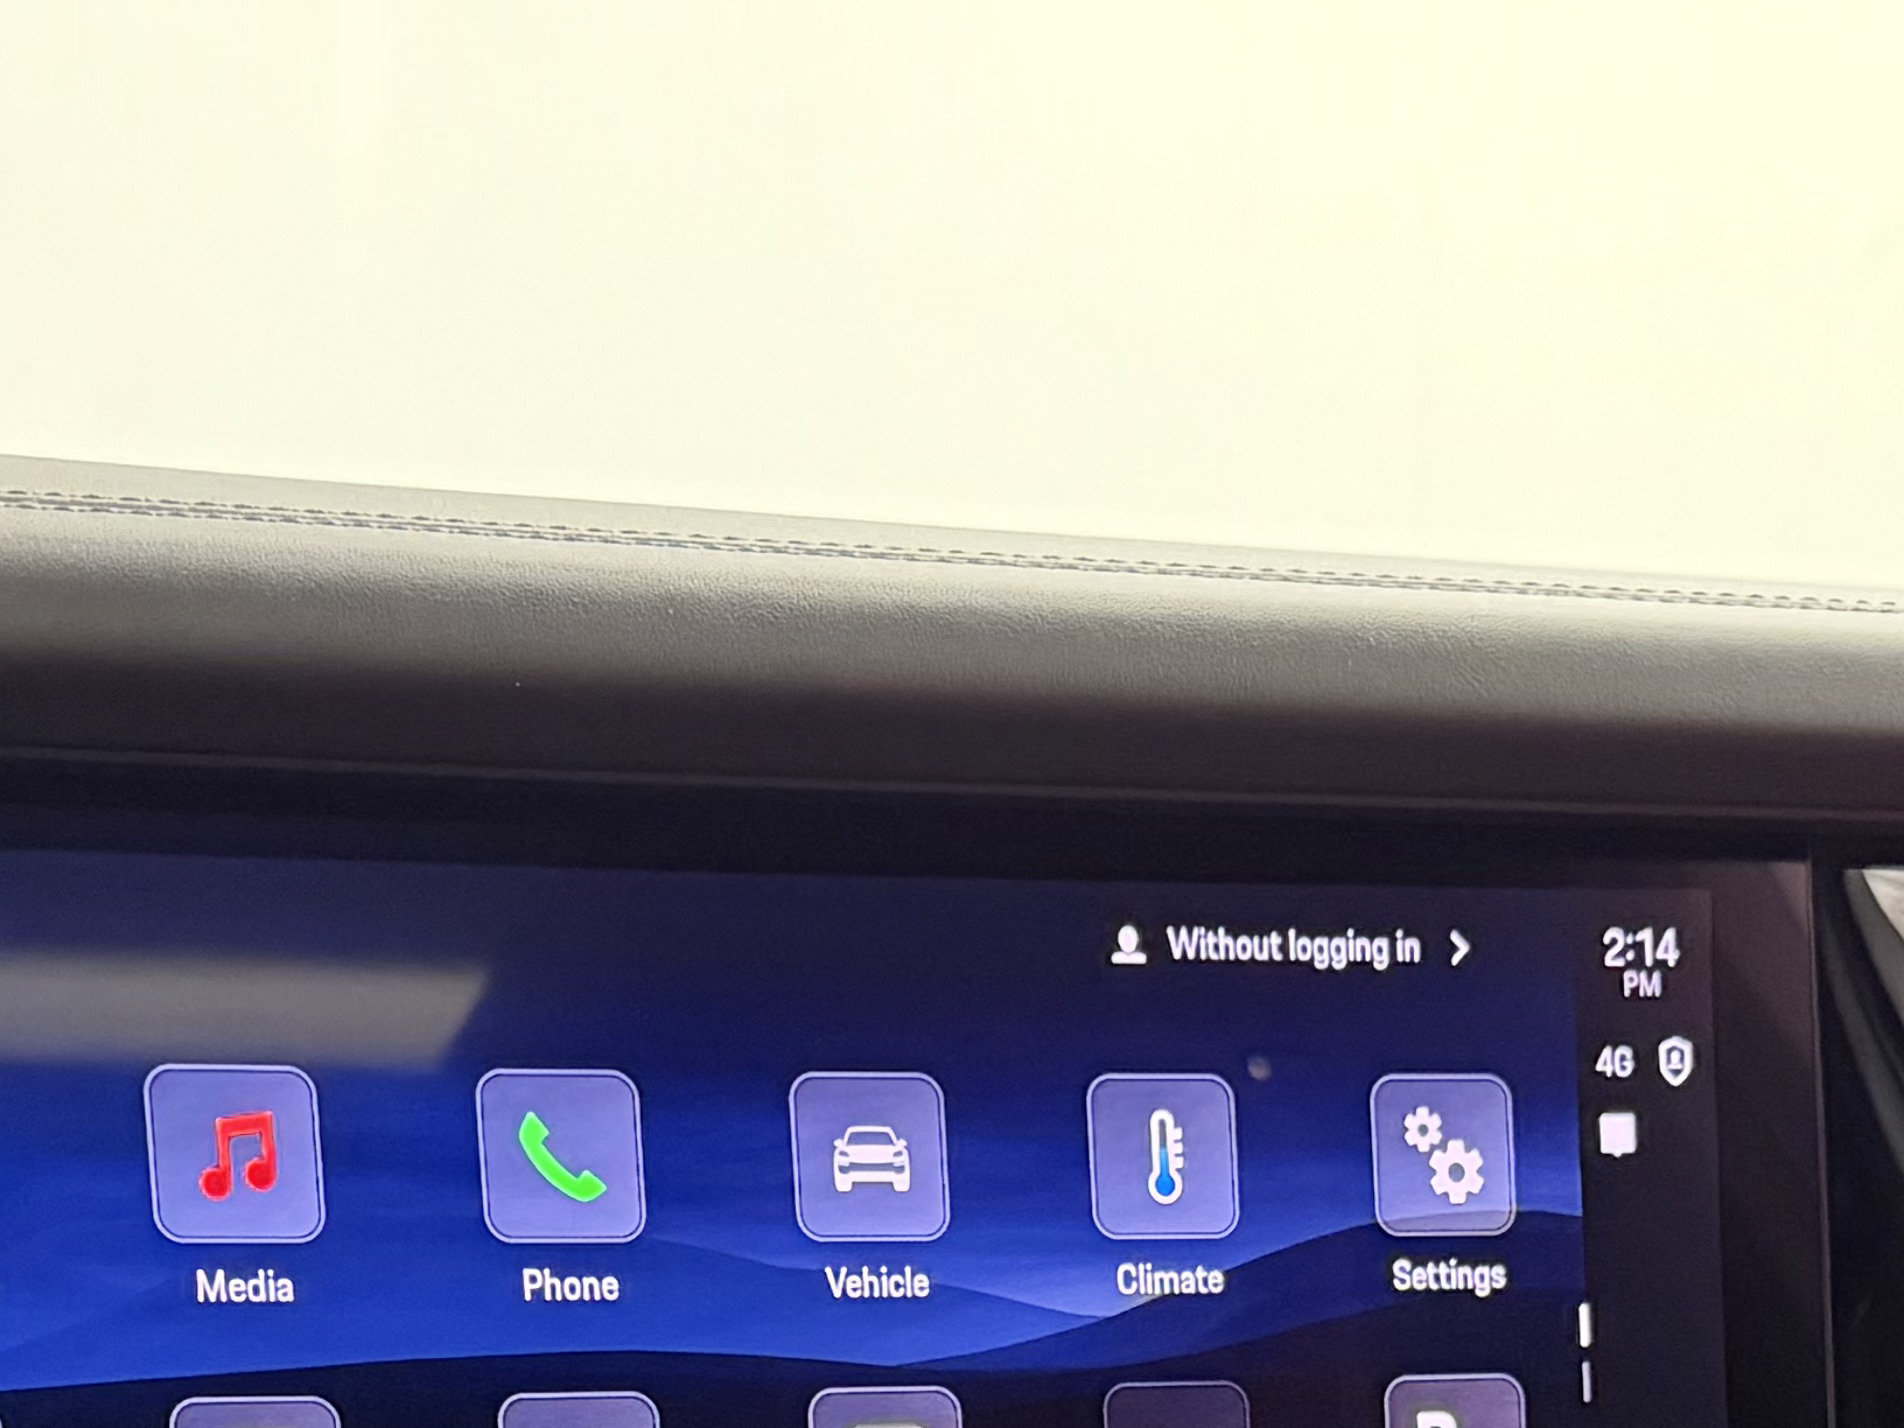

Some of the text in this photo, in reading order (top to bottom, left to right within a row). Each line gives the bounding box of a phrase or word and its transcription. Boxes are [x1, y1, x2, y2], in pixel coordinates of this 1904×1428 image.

[1166, 925, 1422, 971] Without logging in
[1602, 926, 1681, 968] 2:14
[1622, 970, 1663, 999] PM
[1594, 1045, 1636, 1078] 4G
[196, 1268, 295, 1304] Media
[522, 1267, 620, 1303] Phone
[825, 1265, 930, 1299] Vehicle
[1116, 1262, 1224, 1297] Climate
[1392, 1257, 1507, 1298] Settings
